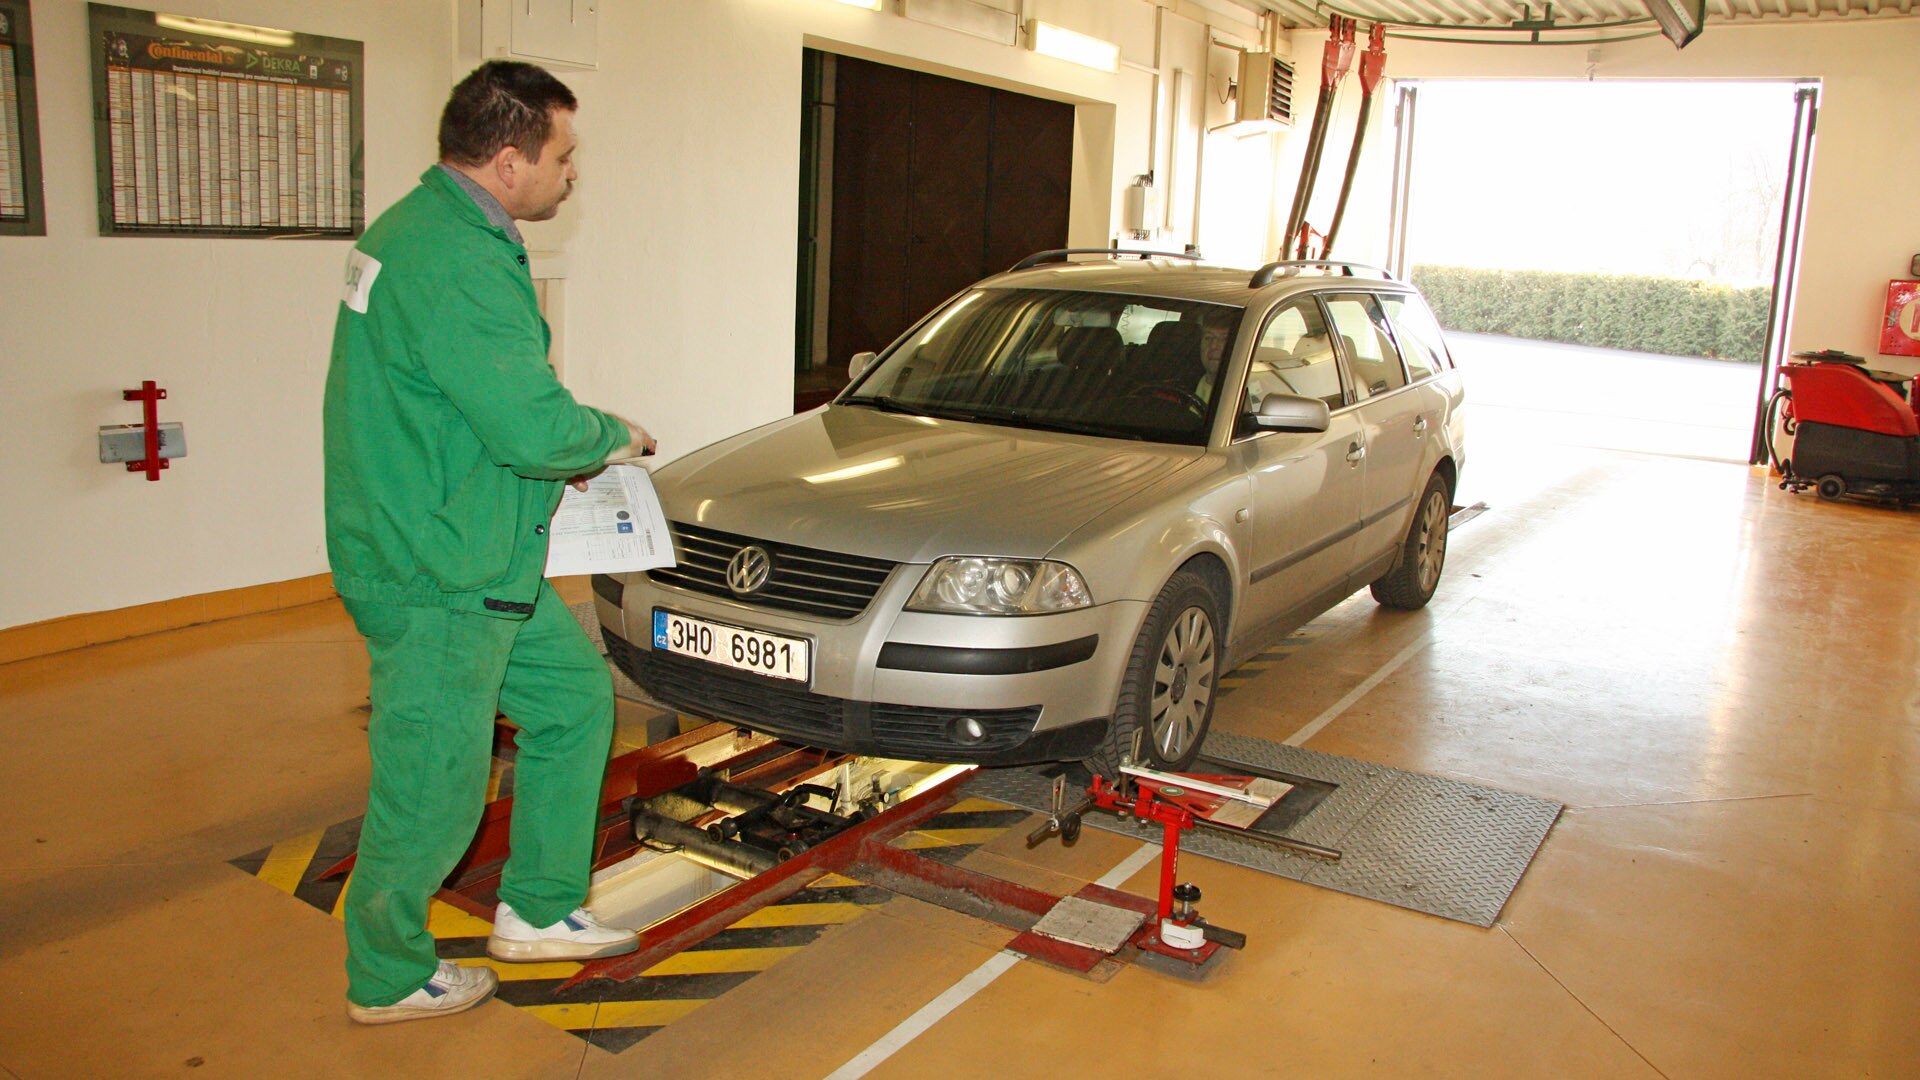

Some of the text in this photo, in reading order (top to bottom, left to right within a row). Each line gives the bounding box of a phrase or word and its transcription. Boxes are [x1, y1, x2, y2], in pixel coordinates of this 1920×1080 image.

[147, 42, 223, 63] Continental
[263, 56, 300, 72] DEKRA
[656, 634, 667, 645] CZ
[673, 620, 790, 673] 3H0 6981
